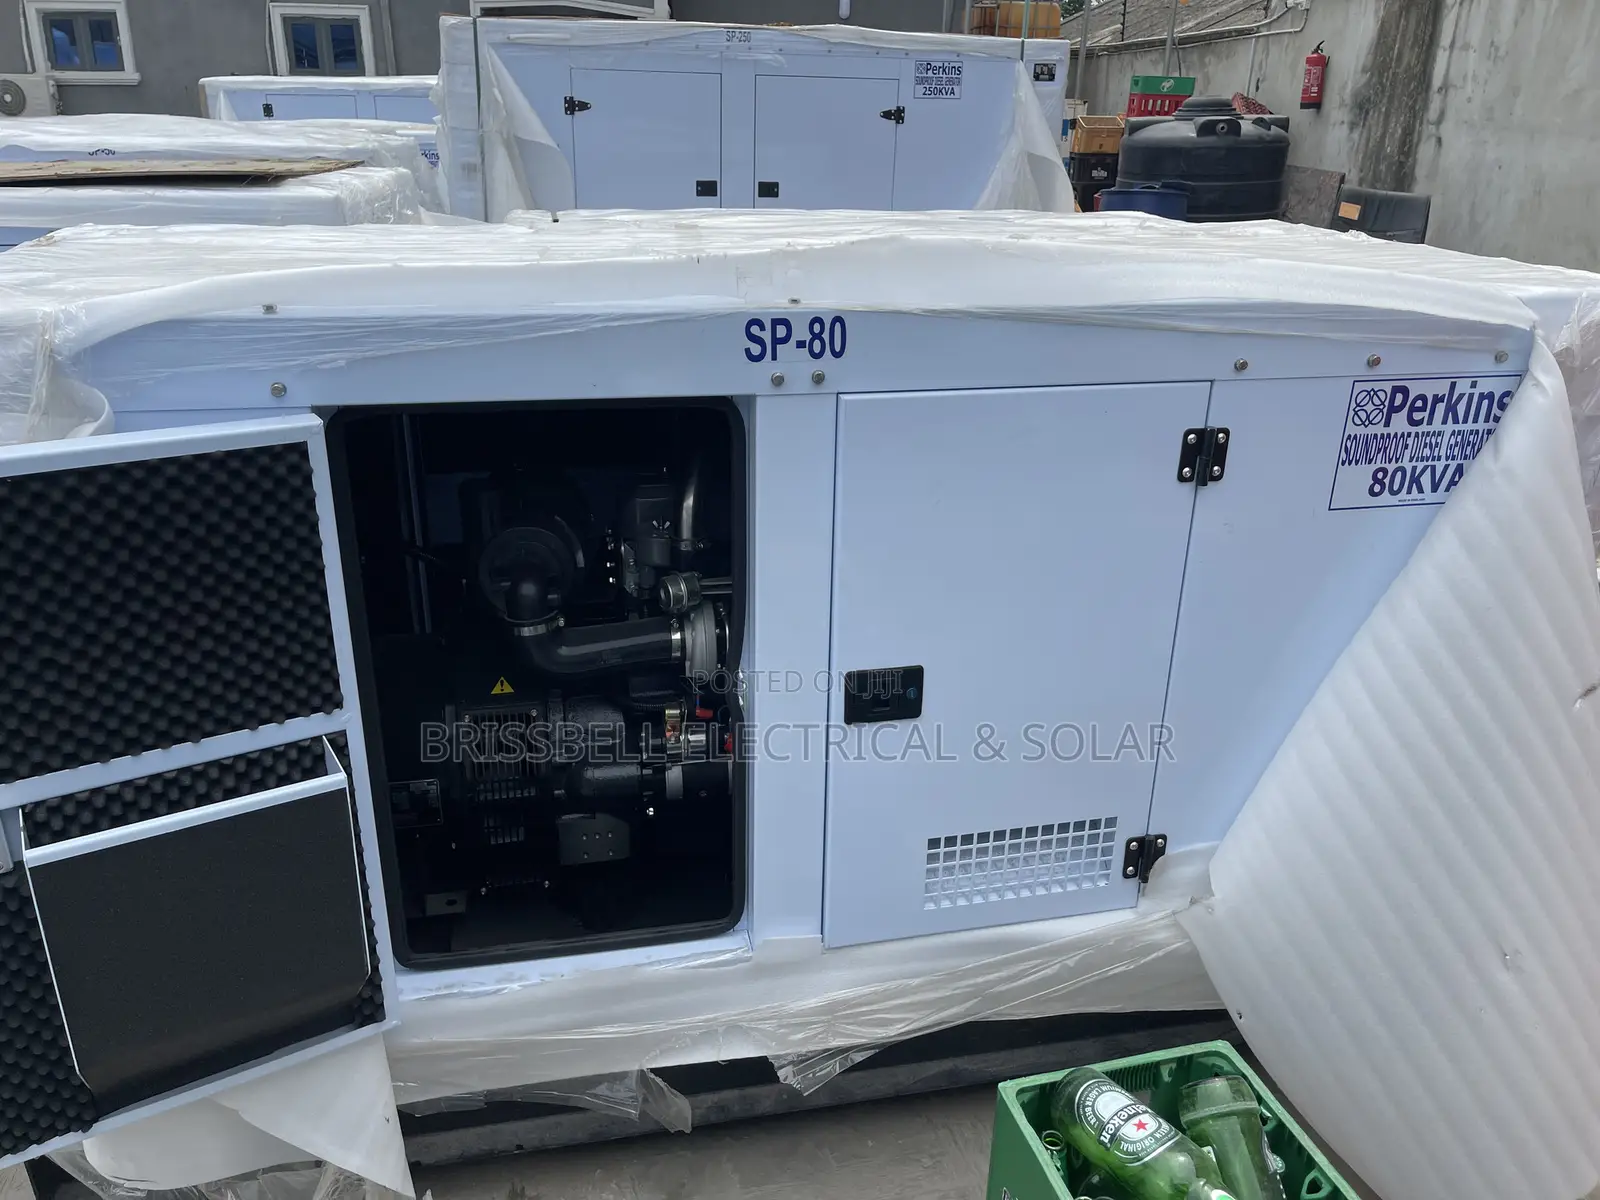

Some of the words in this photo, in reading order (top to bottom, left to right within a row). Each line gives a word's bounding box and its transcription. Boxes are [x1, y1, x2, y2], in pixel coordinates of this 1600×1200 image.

[725, 31, 751, 42] SP-250
[925, 62, 962, 76] Perkins
[922, 86, 956, 96] 250KVA
[744, 315, 847, 362] SP-80
[1383, 380, 1515, 428] Perkins
[1340, 431, 1412, 467] SOUNDPROOF
[1408, 430, 1446, 463] DIESEL
[1445, 428, 1496, 462] GENERAT
[1367, 462, 1465, 498] 80KVA
[1085, 1088, 1102, 1108] LAGER
[1099, 1104, 1147, 1144] eineken
[1119, 1137, 1155, 1152] ORIGINAL
